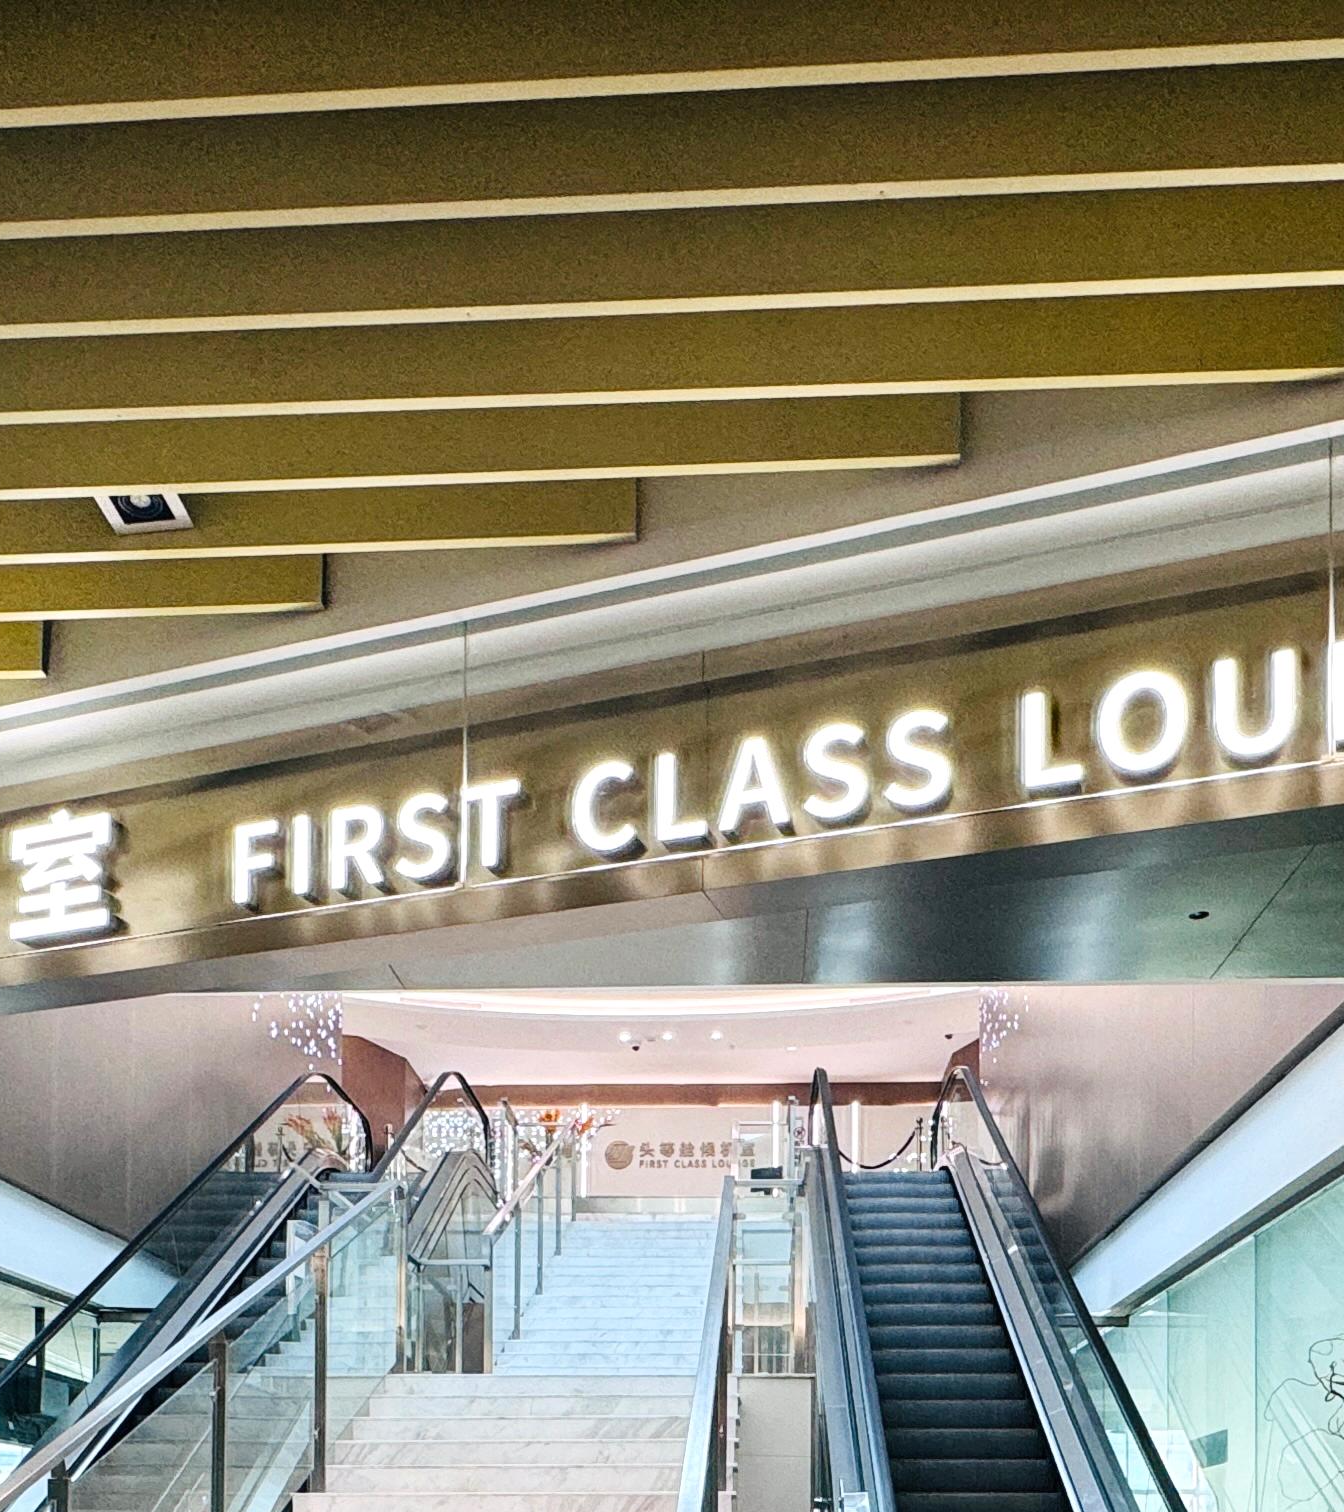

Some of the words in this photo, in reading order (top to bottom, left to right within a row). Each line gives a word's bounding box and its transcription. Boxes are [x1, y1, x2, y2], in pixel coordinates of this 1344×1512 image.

[230, 777, 522, 906] FIRST
[570, 709, 956, 860] CLASS
[640, 1159, 670, 1168] FIRST
[674, 1159, 707, 1168] CLASS
